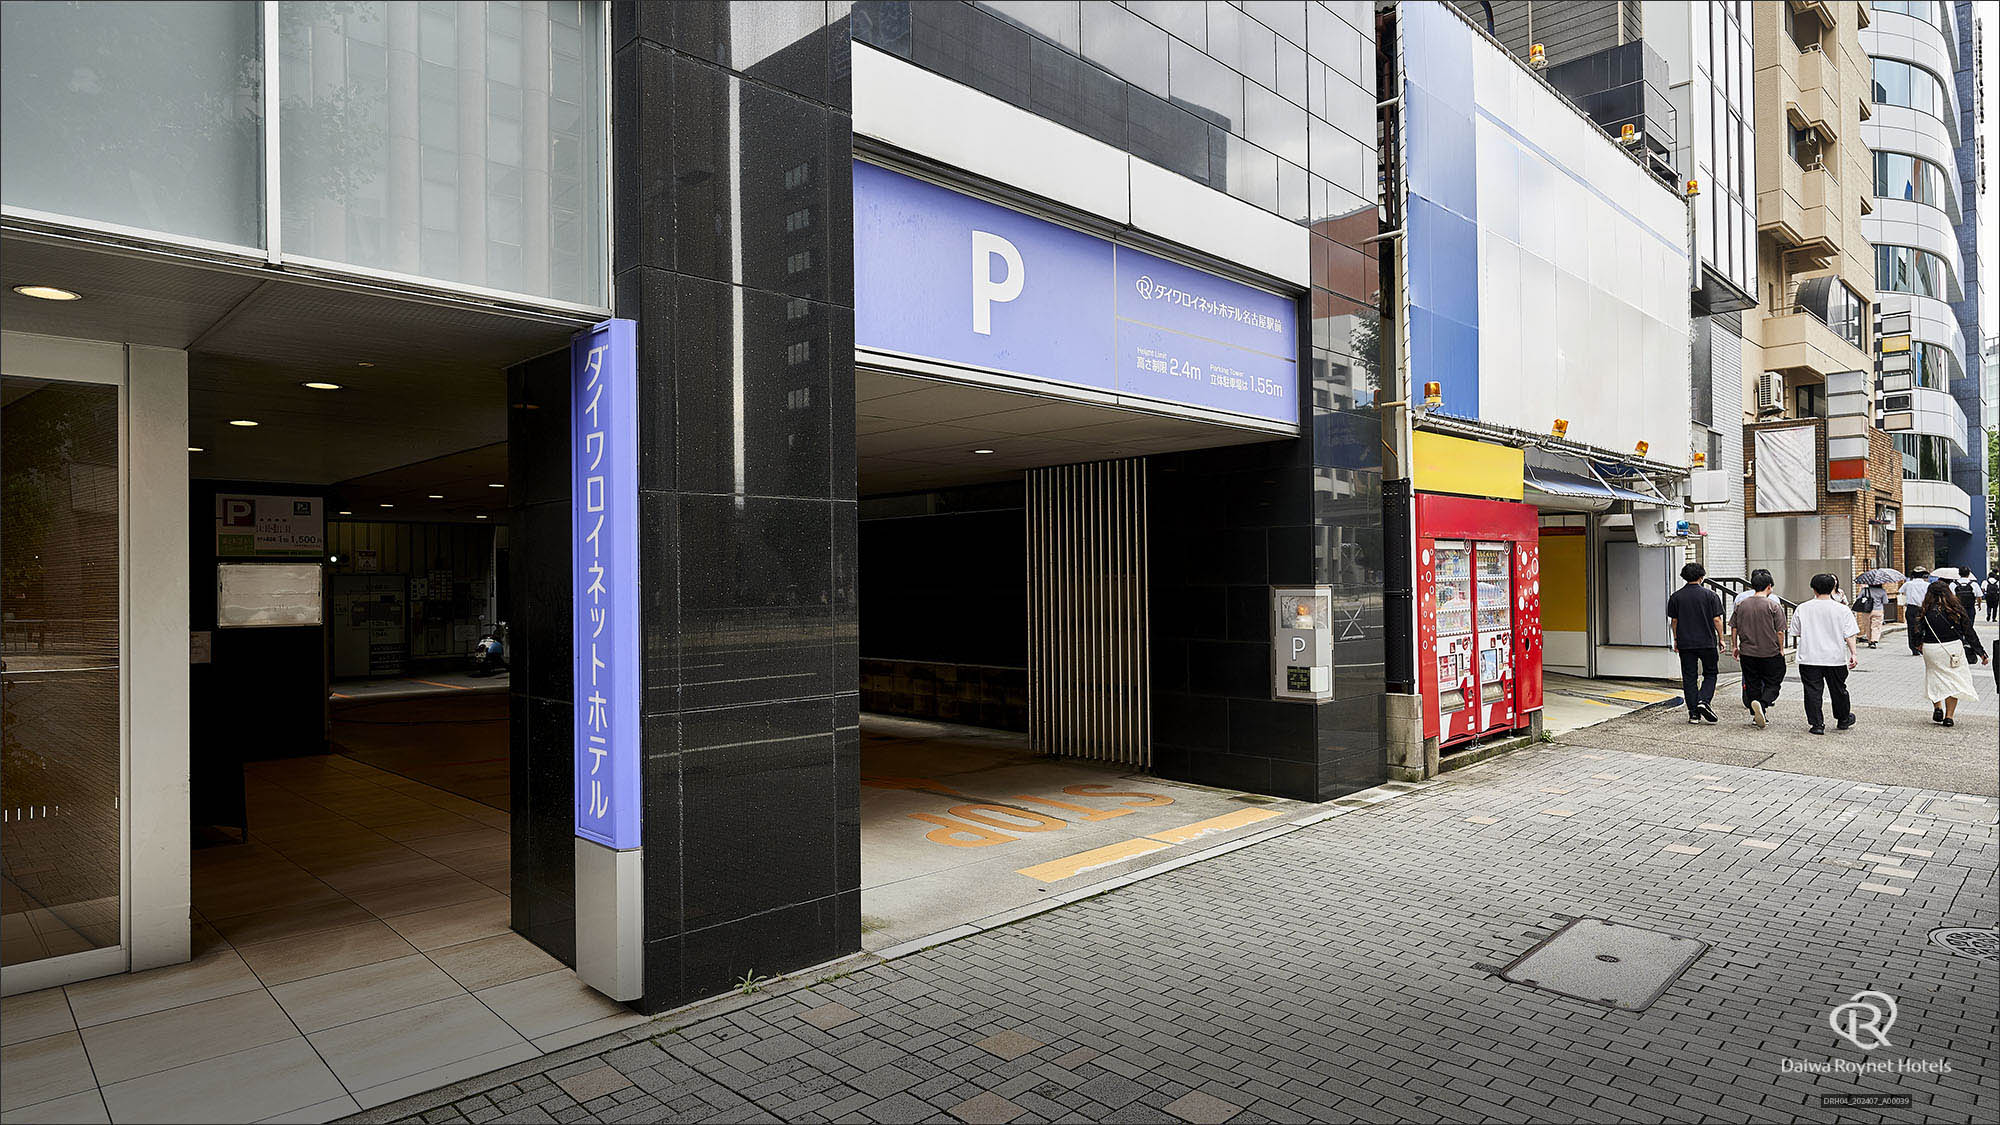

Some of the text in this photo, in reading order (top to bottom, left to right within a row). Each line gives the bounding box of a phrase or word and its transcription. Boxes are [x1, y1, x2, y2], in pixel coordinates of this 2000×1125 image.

[972, 230, 1025, 336] P
[1154, 284, 1282, 333] ダイワロイネットホテル名古屋駅前
[1169, 358, 1202, 381] 2.4m
[1210, 363, 1229, 375] Parking
[1249, 375, 1284, 398] 1.55m
[226, 500, 252, 525] P
[584, 344, 609, 820] ダイワロイネットホテル
[1292, 637, 1306, 660] P
[906, 783, 1176, 848] STOP
